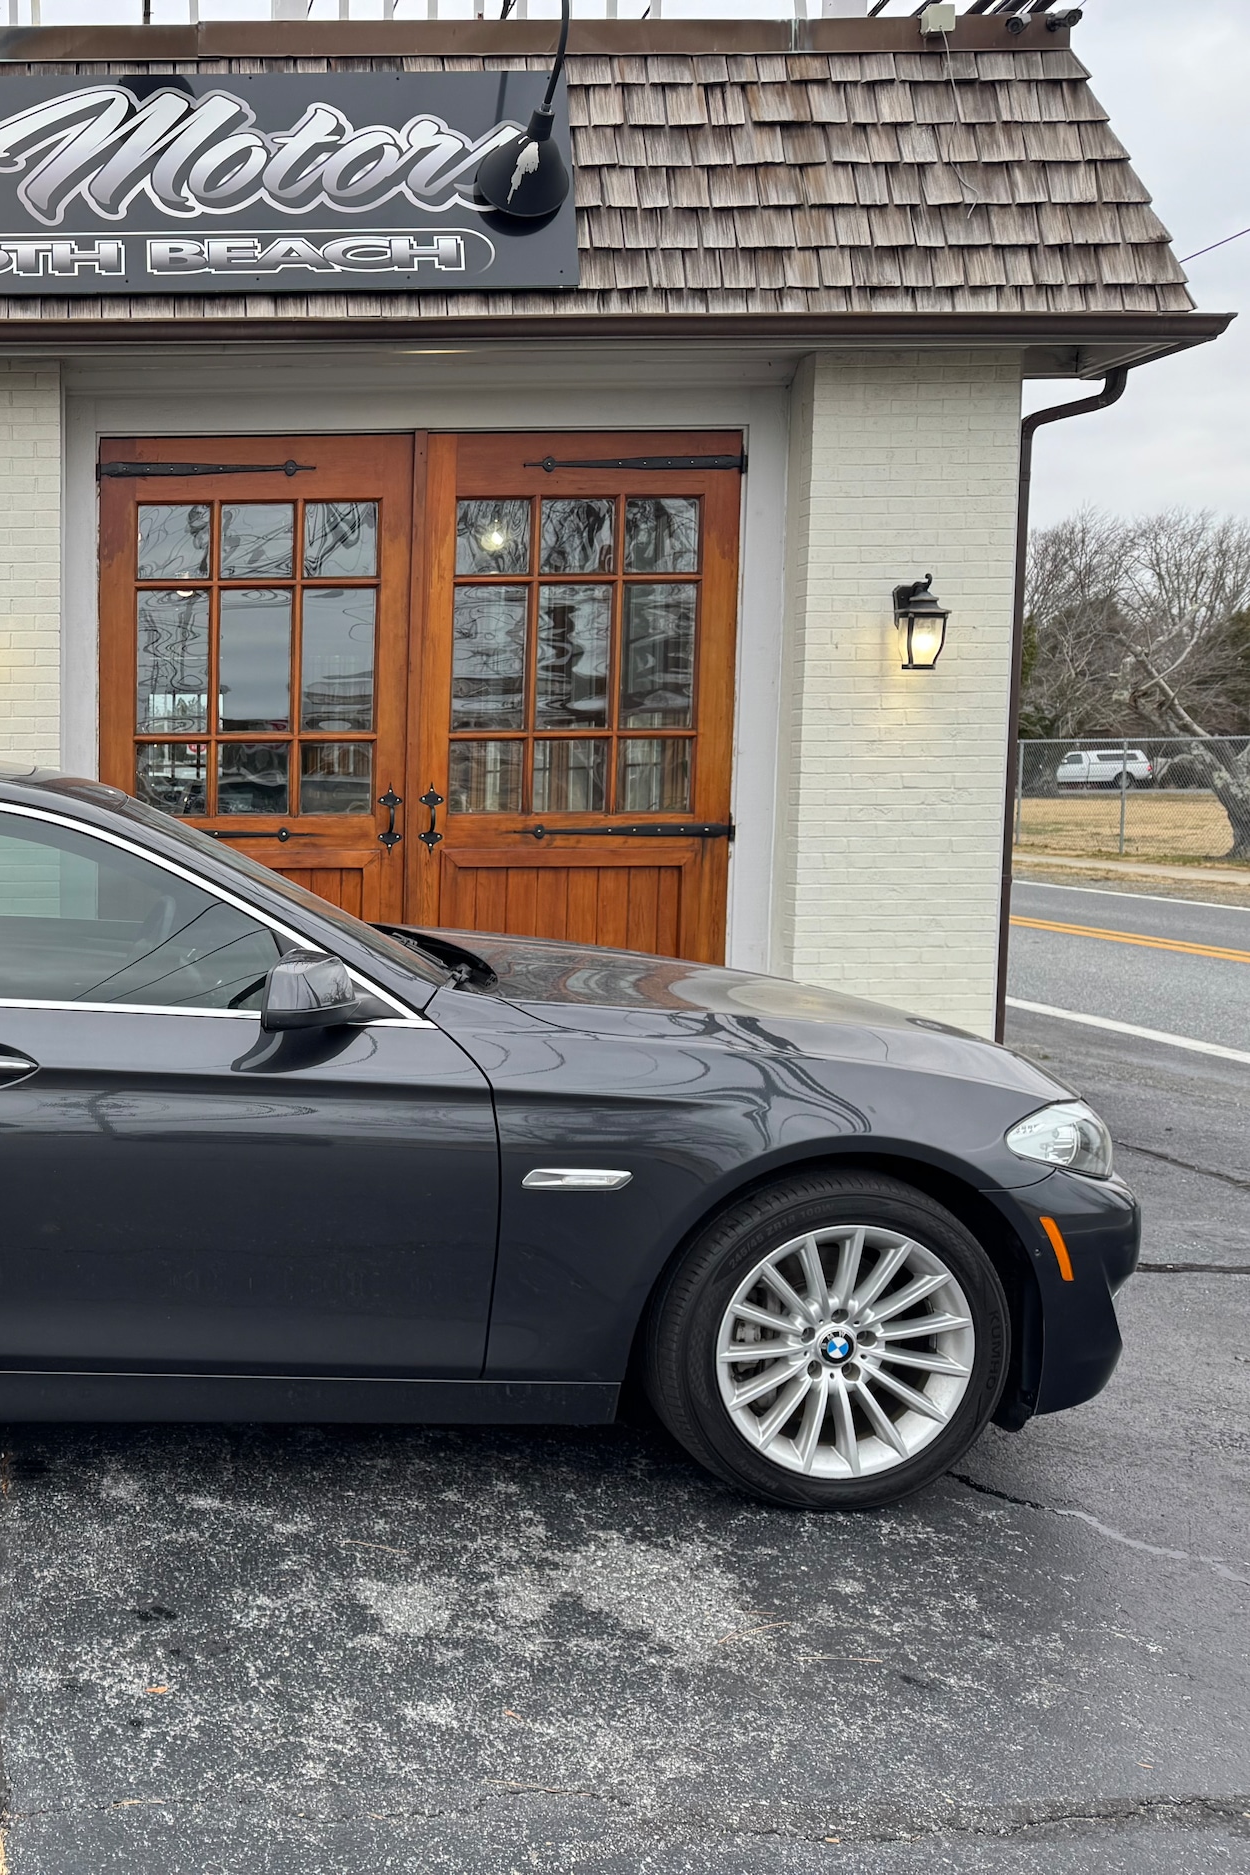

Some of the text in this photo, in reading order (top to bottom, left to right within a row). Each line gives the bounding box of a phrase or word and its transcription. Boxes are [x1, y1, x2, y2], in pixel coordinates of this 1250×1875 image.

[146, 236, 466, 274] BEACH
[765, 1214, 796, 1237] ZR18
[800, 1203, 835, 1218] 100W
[985, 1310, 1002, 1391] KUMHO
